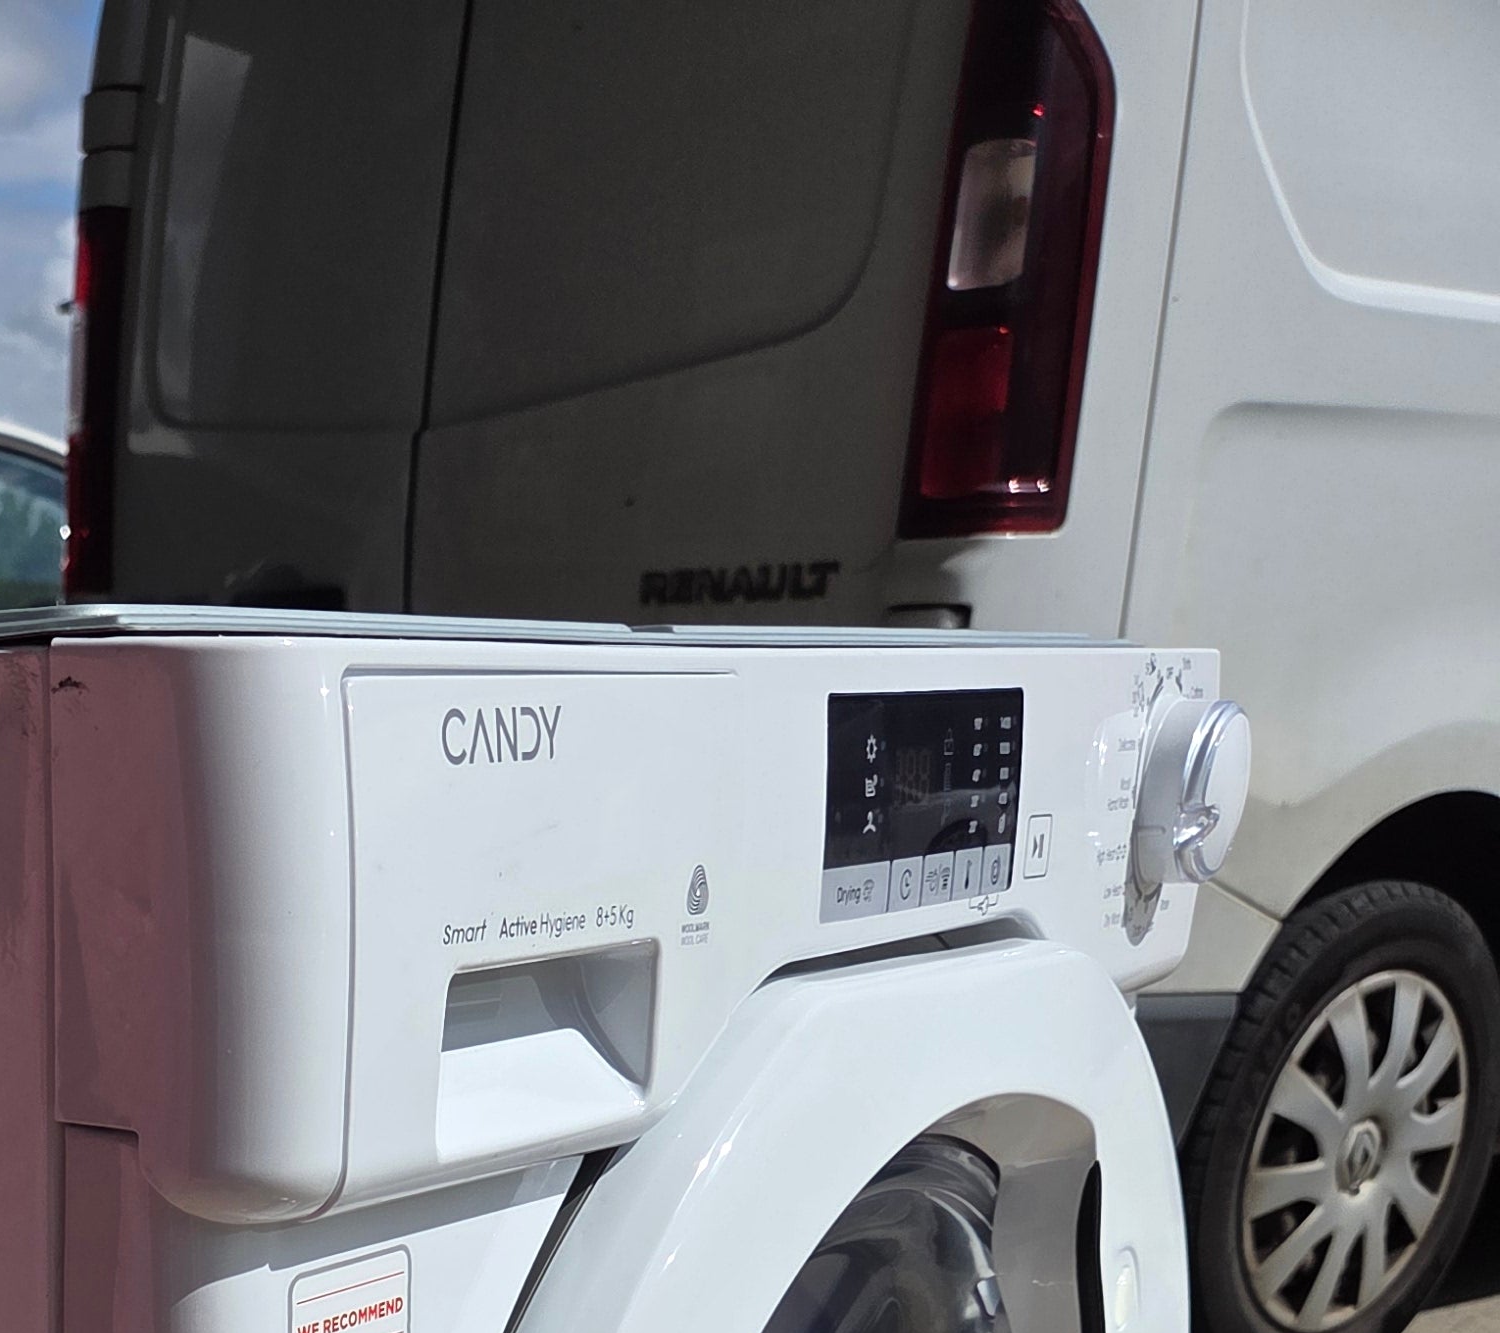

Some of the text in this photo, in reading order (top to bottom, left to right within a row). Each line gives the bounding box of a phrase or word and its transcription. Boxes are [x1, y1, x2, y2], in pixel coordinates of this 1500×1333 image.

[640, 561, 840, 605] RENAULT
[441, 705, 561, 765] CANDY
[442, 918, 487, 945] Smart
[499, 915, 537, 939] Active
[539, 911, 586, 938] Hygiene
